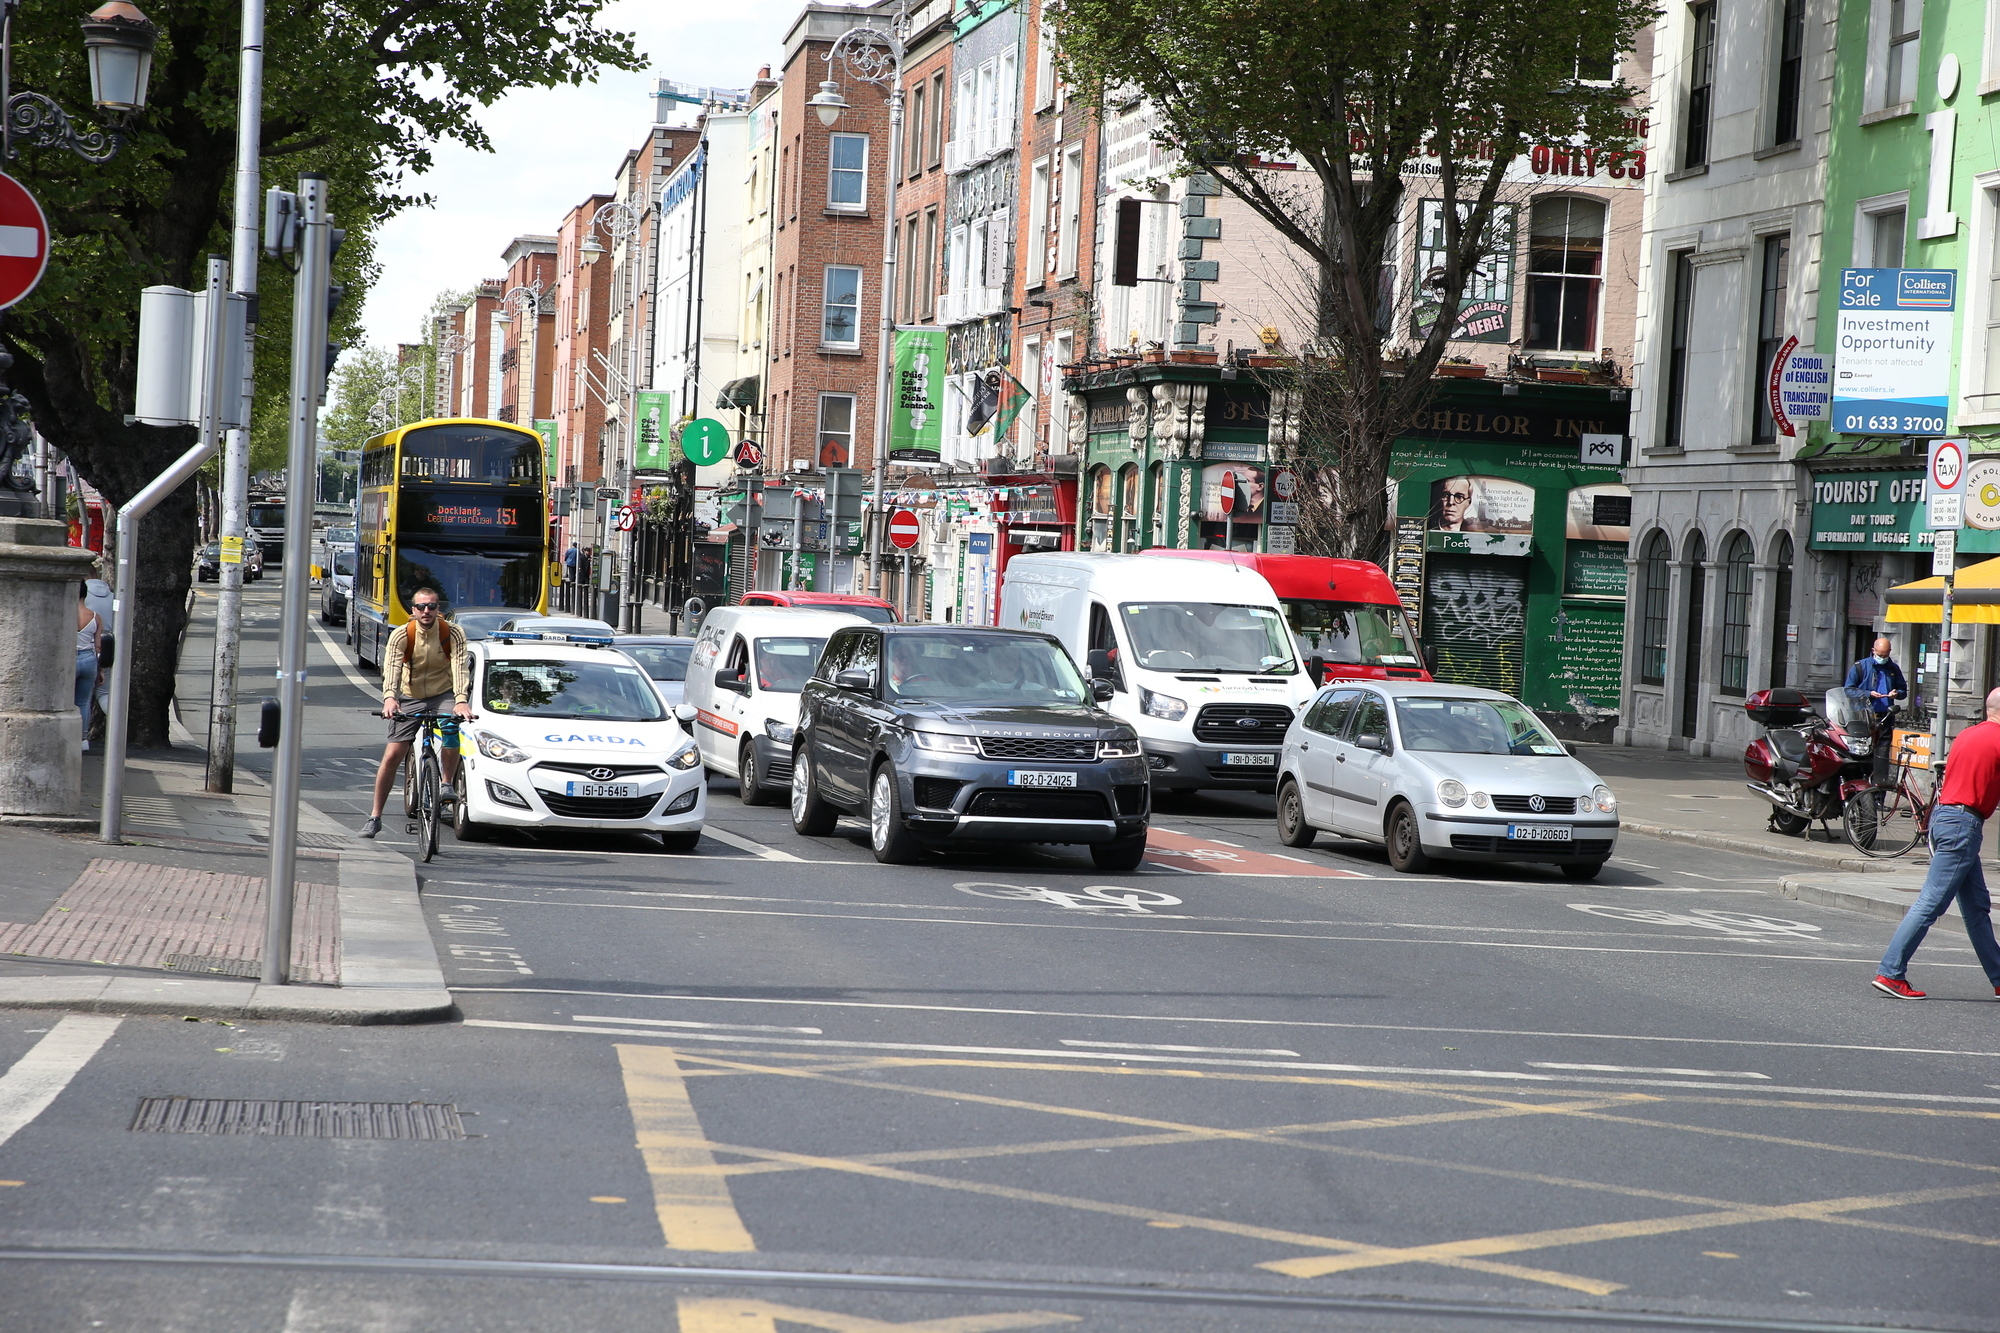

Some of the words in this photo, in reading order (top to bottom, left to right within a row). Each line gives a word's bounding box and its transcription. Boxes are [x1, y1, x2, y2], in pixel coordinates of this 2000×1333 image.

[1531, 145, 1600, 177] ONLY
[957, 161, 1010, 219] ABBEY
[1844, 271, 1875, 287] For
[1904, 278, 1946, 289] Colliers
[1843, 290, 1881, 306] Sale
[1457, 302, 1509, 323] AVAILABLE
[1467, 314, 1505, 336] HERE!
[1843, 317, 1930, 332] Investment
[950, 321, 1000, 369] COURT
[1842, 335, 1935, 353] Opportunity
[1792, 357, 1823, 370] SCHOOL
[1841, 357, 1872, 366] Tenants
[1875, 358, 1888, 366] not
[1890, 358, 1923, 367] affected
[1785, 371, 1794, 382] of
[1795, 372, 1828, 384] ENGLISH
[901, 386, 922, 395] agus
[1783, 391, 1828, 403] TRANSLATION
[900, 401, 935, 410] Iontach
[1223, 401, 1250, 420] 31
[1788, 404, 1821, 416] SERVICES
[1401, 411, 1530, 436] CHELOR
[1554, 418, 1605, 437] INN
[1846, 415, 1863, 429] 01
[1869, 416, 1897, 430] 633
[1903, 417, 1943, 431] 3700
[1413, 450, 1423, 458] of
[1434, 451, 1448, 459] evil
[1528, 461, 1537, 469] up
[1538, 459, 1549, 467] for
[1556, 460, 1566, 471] by
[1567, 463, 1586, 471] being
[1938, 464, 1957, 476] TAXI
[1968, 473, 1980, 488] THE
[1814, 480, 1879, 504] TOURIST
[1889, 478, 1927, 503] OFFI
[1500, 494, 1512, 502] light
[438, 505, 482, 515] Docklands
[496, 507, 518, 525] 151
[427, 514, 457, 523] Ceantar
[457, 515, 467, 523] na
[1850, 514, 1865, 525] DAY
[1870, 514, 1895, 525] TOURS
[1816, 531, 1865, 543] INFORMATION
[1872, 532, 1910, 543] LUGGAGE
[1580, 550, 1597, 559] The
[1611, 647, 1622, 655] day
[1584, 655, 1605, 664] danger
[1562, 663, 1579, 672] along
[1590, 674, 1605, 682] grief
[982, 729, 1033, 737] RANGE
[544, 734, 646, 747] GARDA
[1917, 755, 1929, 765] OFF
[1020, 774, 1072, 787] 182-D-24125
[582, 785, 628, 797] 151-D-6415
[1516, 828, 1569, 840] 02-D-120603
